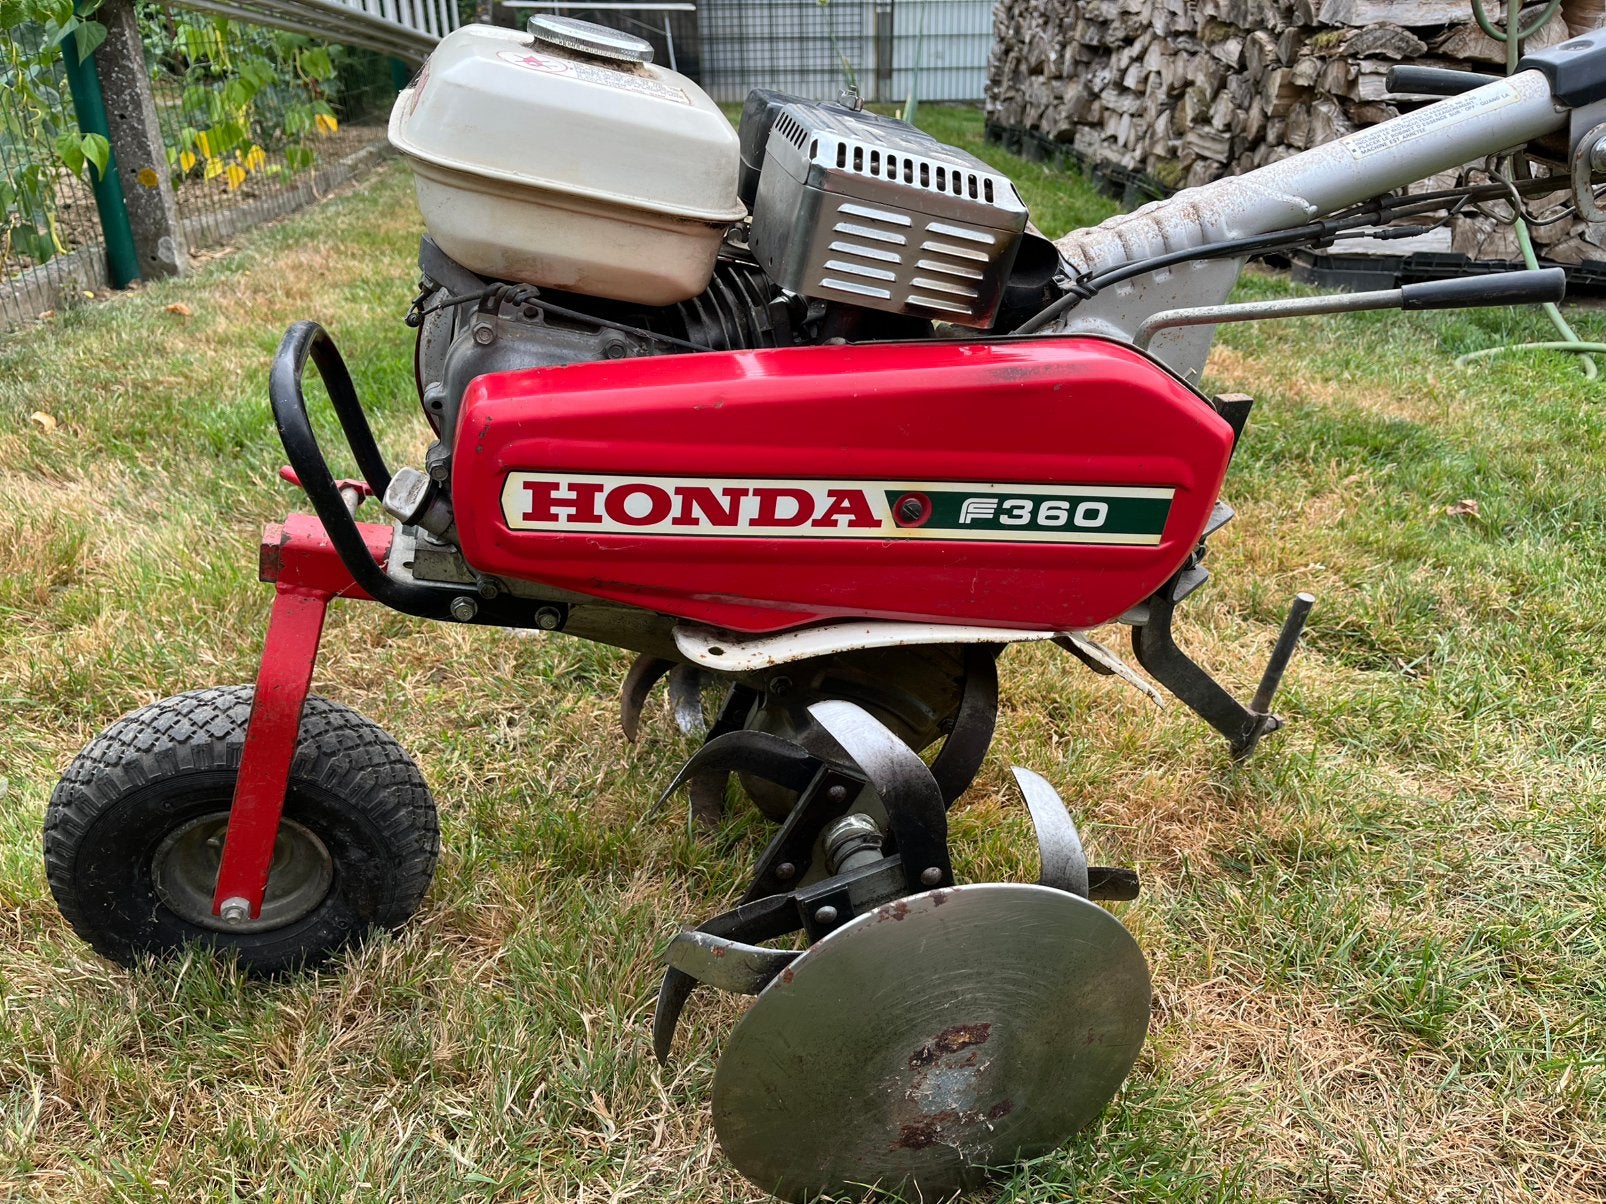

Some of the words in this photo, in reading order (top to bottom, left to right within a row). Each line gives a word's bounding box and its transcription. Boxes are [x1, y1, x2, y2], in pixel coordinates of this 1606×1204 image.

[1358, 139, 1381, 150] PLACER
[1391, 126, 1414, 138] ROBINET
[1361, 141, 1387, 154] MACHINE
[522, 480, 883, 528] HONDA
[958, 497, 1109, 528] F360
